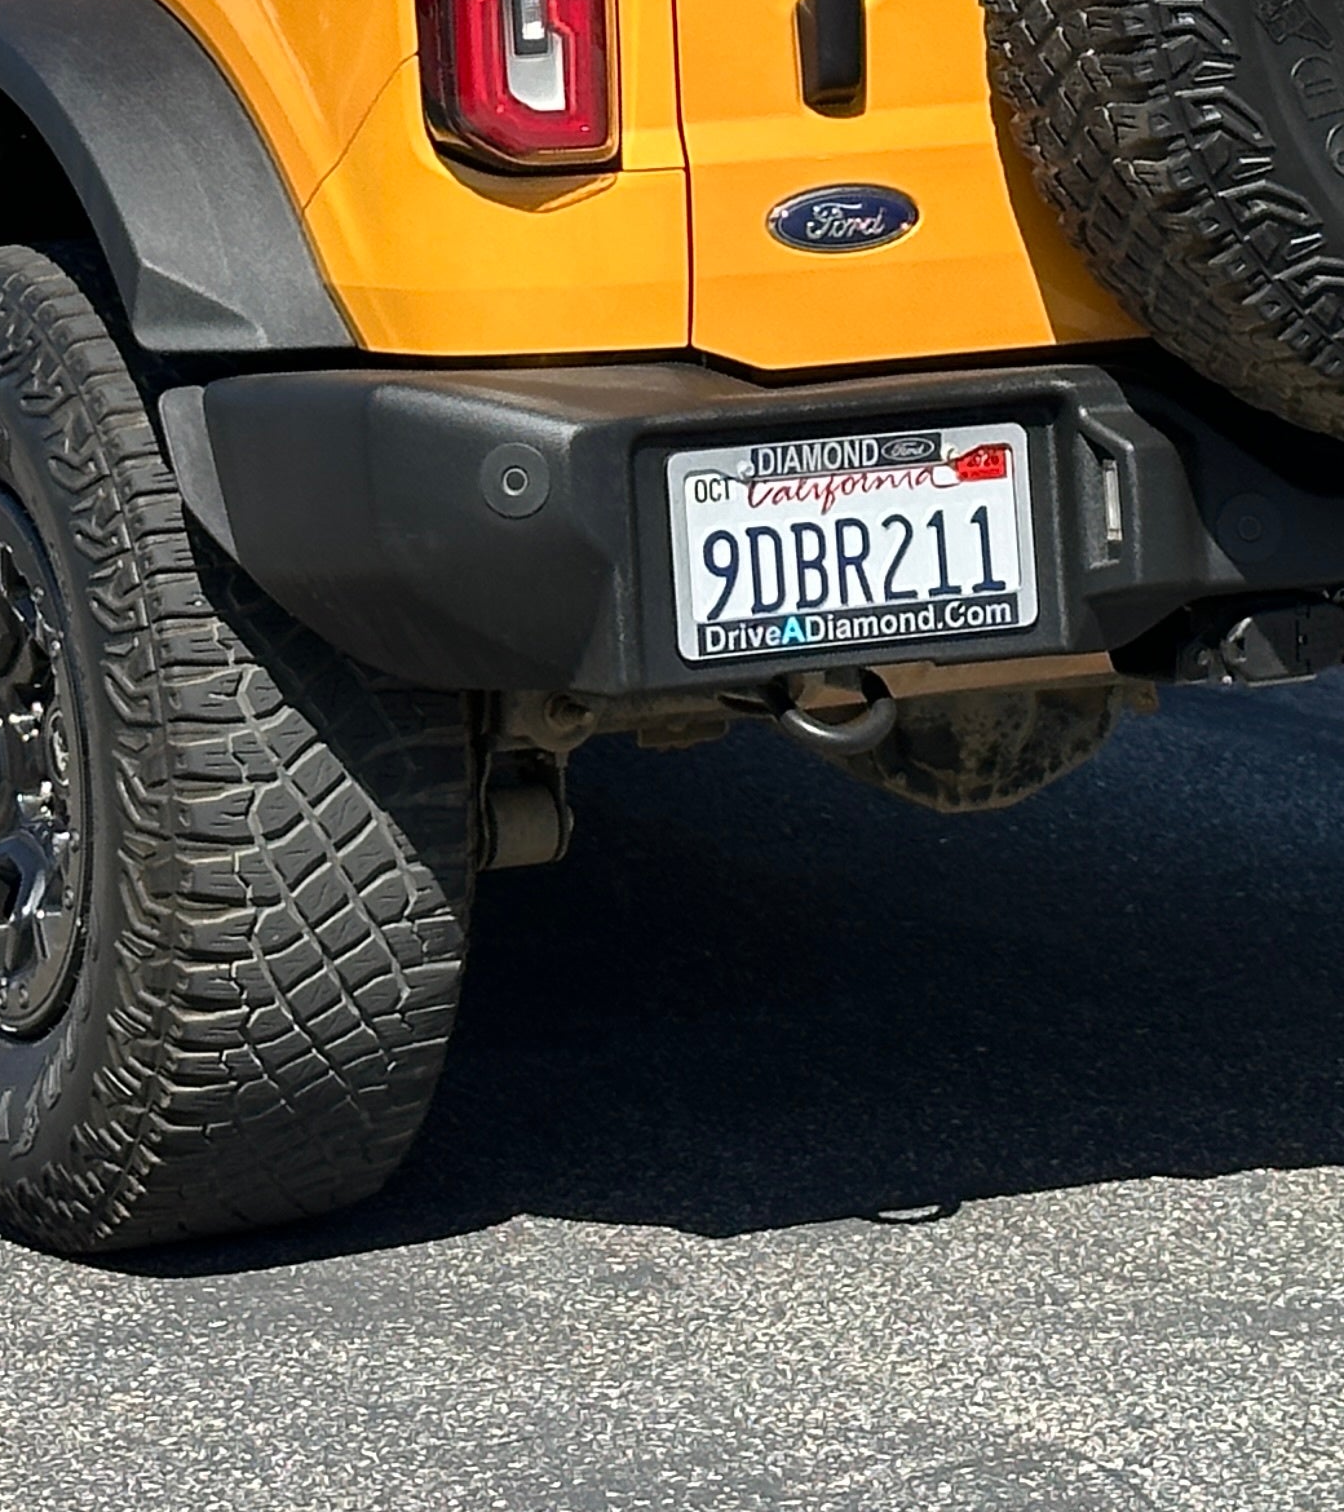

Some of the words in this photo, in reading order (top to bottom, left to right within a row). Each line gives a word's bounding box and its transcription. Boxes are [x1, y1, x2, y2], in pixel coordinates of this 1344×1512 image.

[807, 202, 886, 239] Ford
[758, 438, 879, 475] DIAMOND
[694, 477, 730, 504] OCT
[702, 505, 1007, 621] 9DBR211
[705, 599, 1012, 654] DriveADiamond.Com
